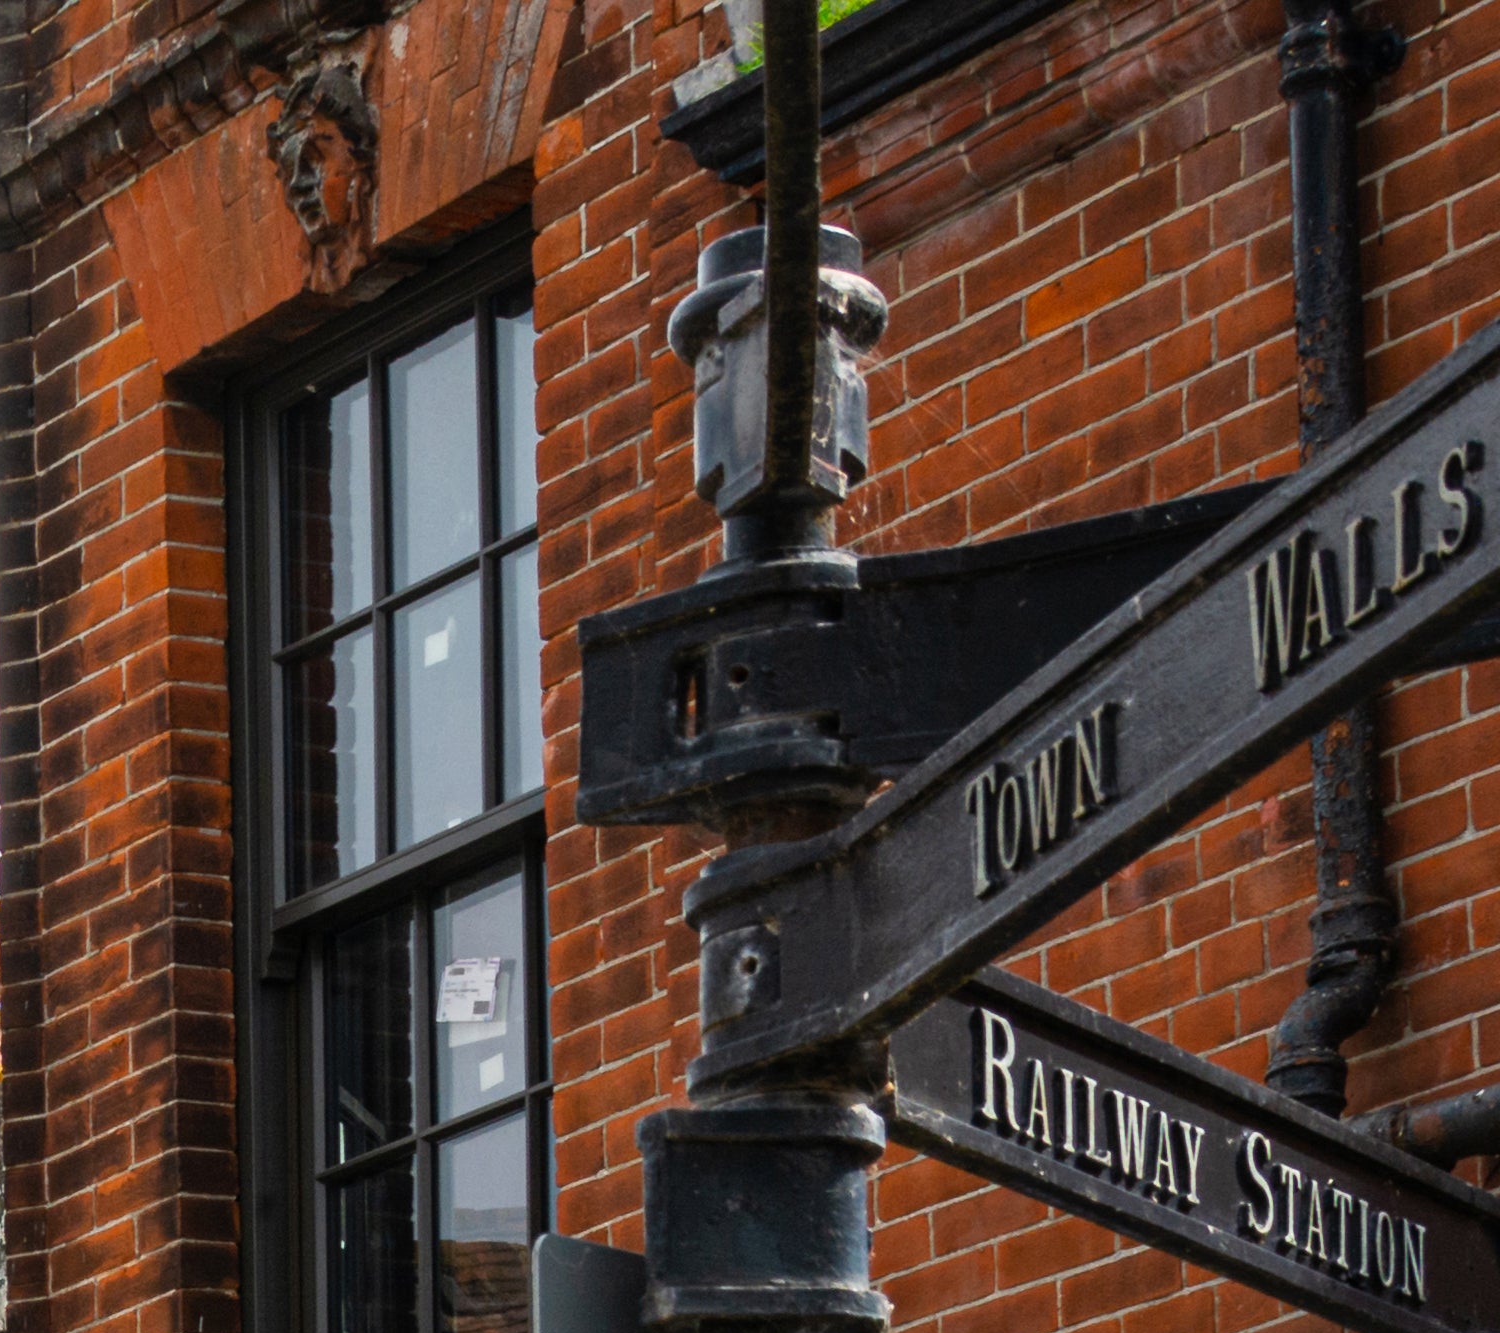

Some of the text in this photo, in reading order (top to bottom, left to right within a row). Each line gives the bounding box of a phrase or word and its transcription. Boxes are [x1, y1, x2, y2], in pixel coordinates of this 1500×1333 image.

[965, 441, 1480, 899] TOWN WALLS
[978, 1007, 1427, 1302] RAILWAY STATION
